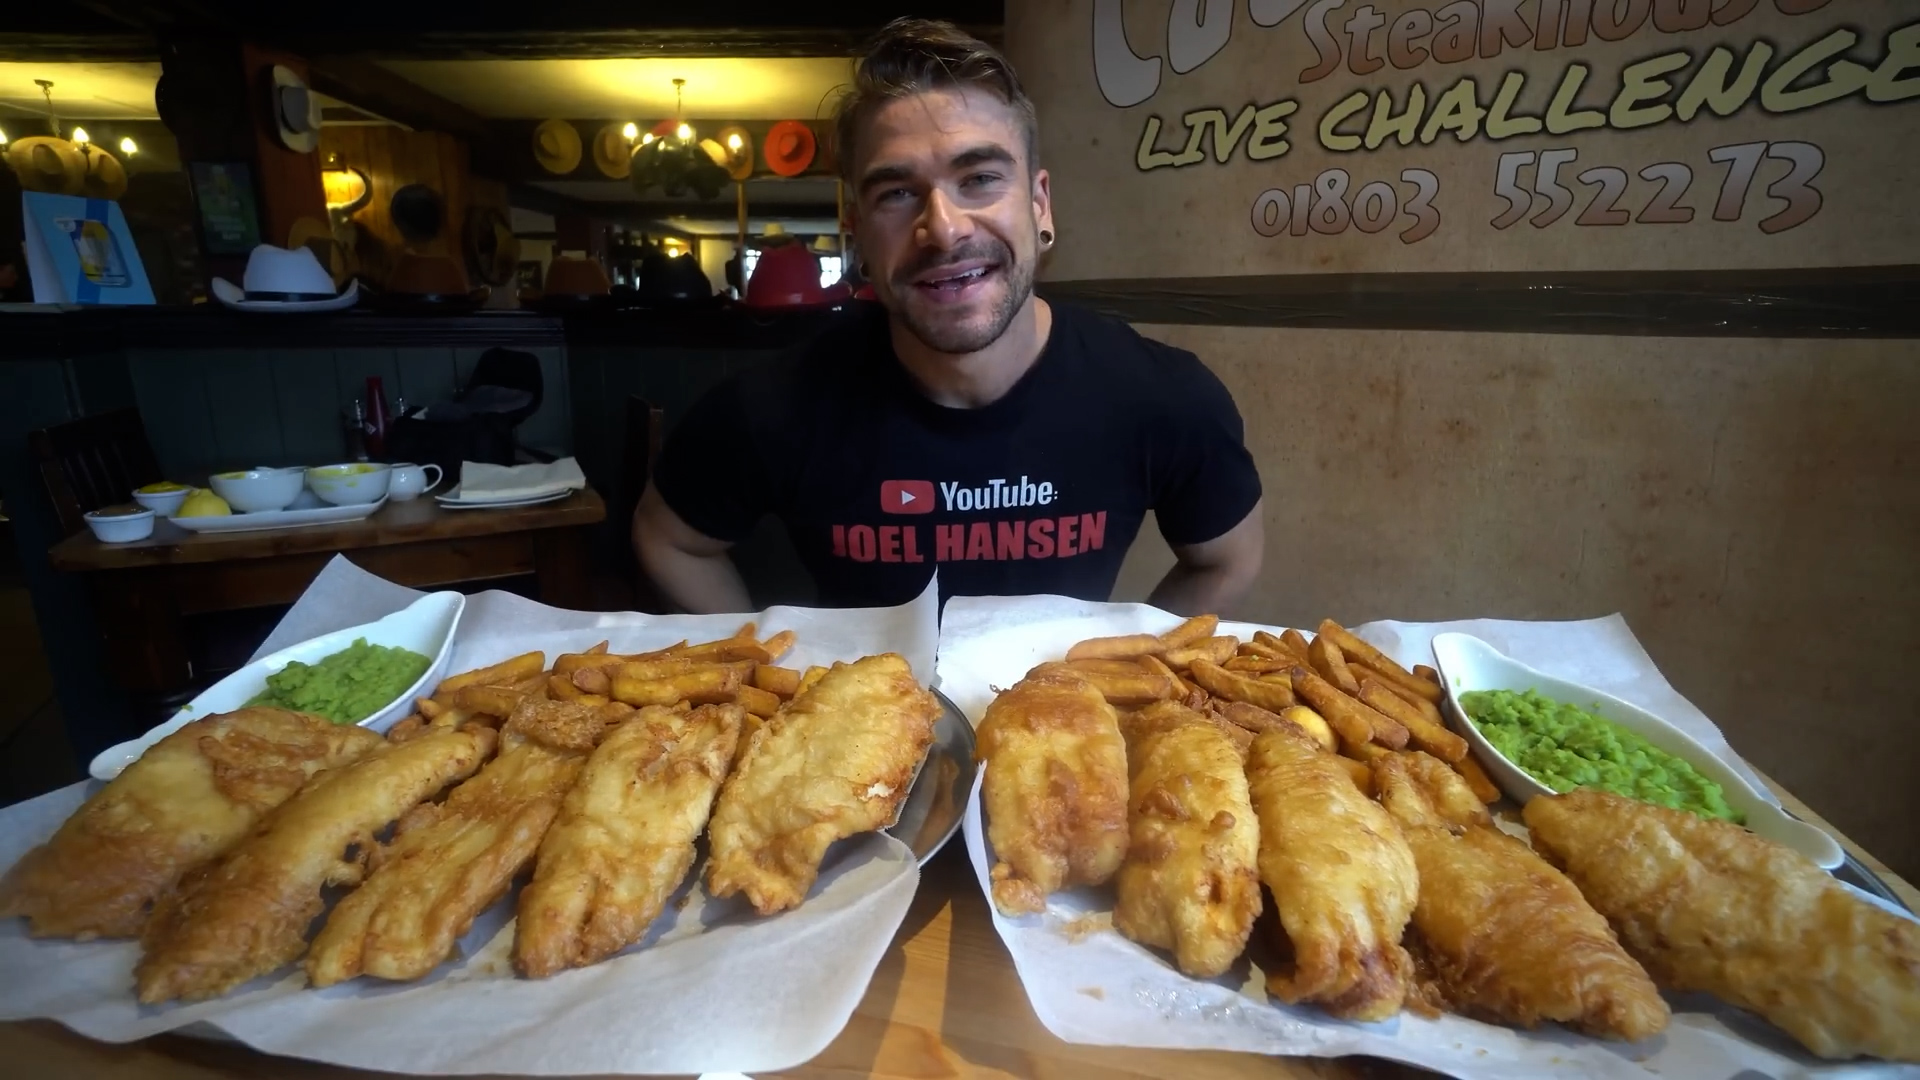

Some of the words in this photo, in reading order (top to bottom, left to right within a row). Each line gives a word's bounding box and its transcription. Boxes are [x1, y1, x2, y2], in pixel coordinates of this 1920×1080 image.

[1299, 0, 1836, 84] Steakhou
[1137, 100, 1299, 170] LIVE
[1318, 23, 1920, 152] CHALLENGE
[1250, 168, 1441, 244] 01803
[1490, 141, 1826, 235] 552273
[832, 523, 925, 563] JOEL
[935, 510, 1108, 562] HANSEN
